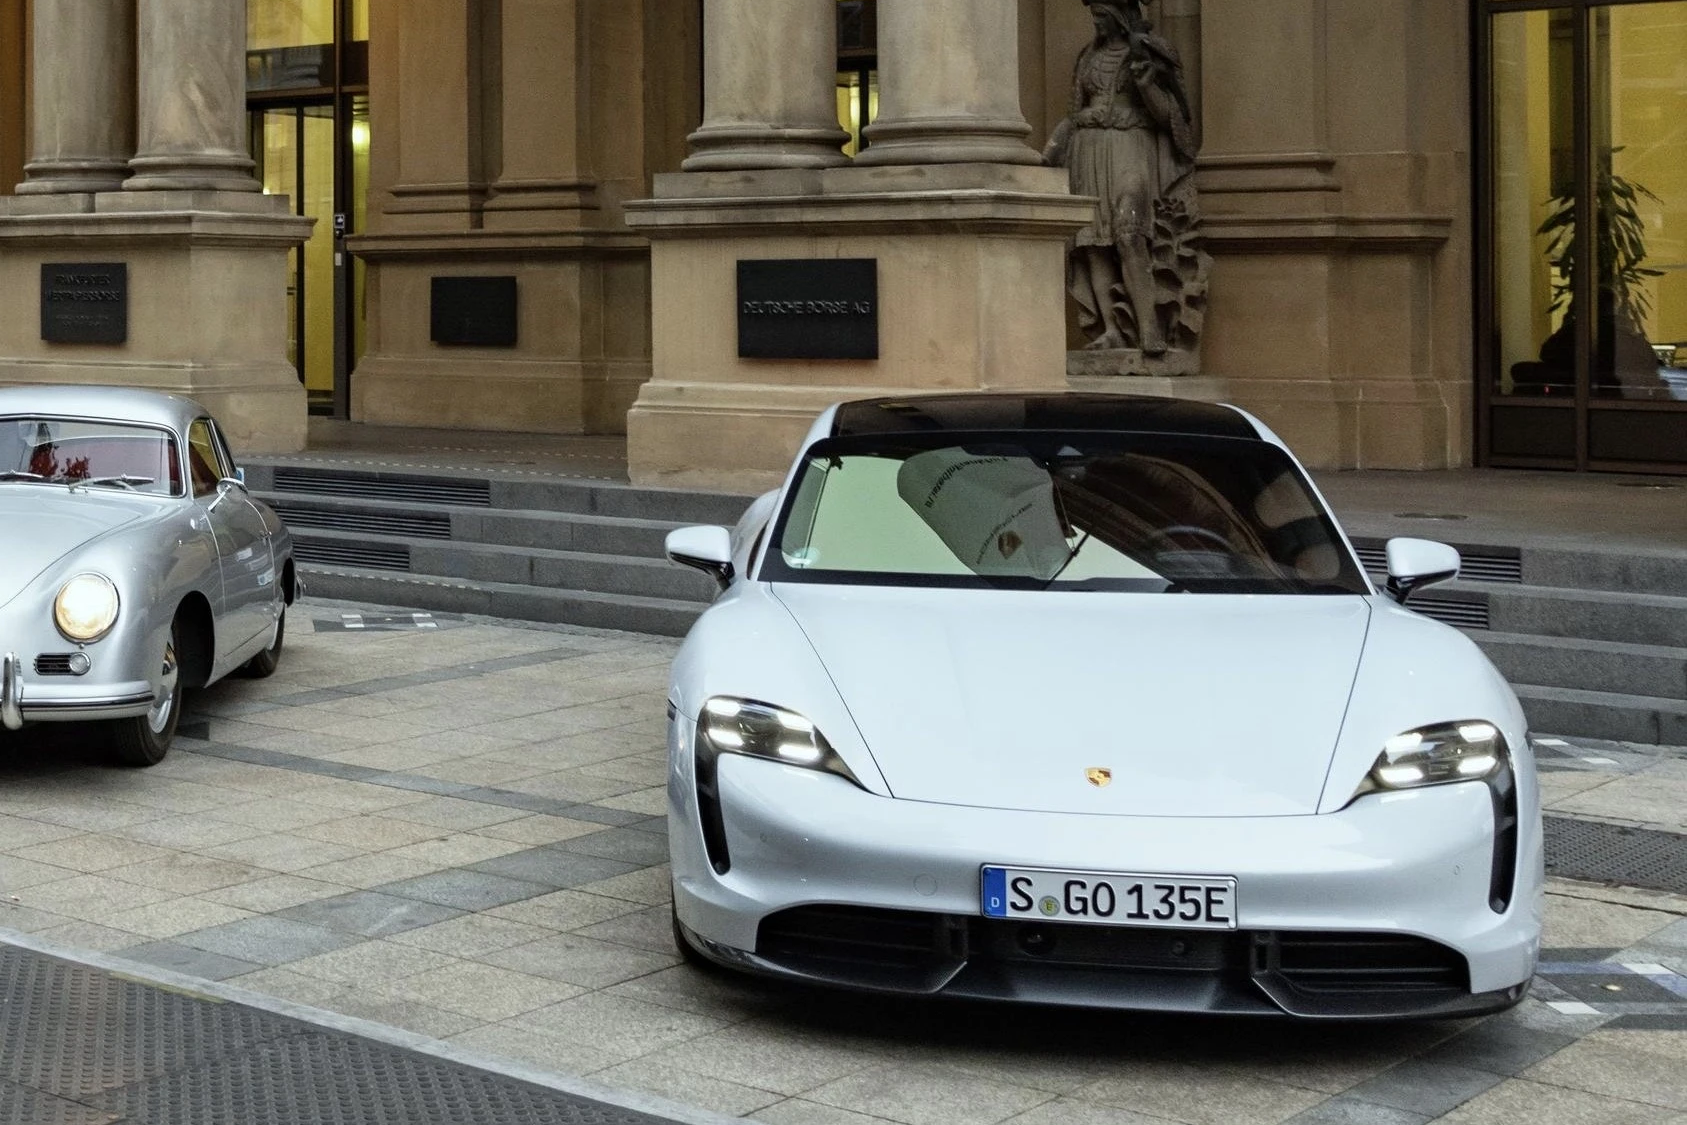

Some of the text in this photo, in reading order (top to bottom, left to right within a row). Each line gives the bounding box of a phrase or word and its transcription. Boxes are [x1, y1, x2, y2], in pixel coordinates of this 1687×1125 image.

[743, 301, 804, 314] DEUTSCHE
[853, 301, 871, 314] AG
[991, 876, 1230, 923] D S GO 135E
